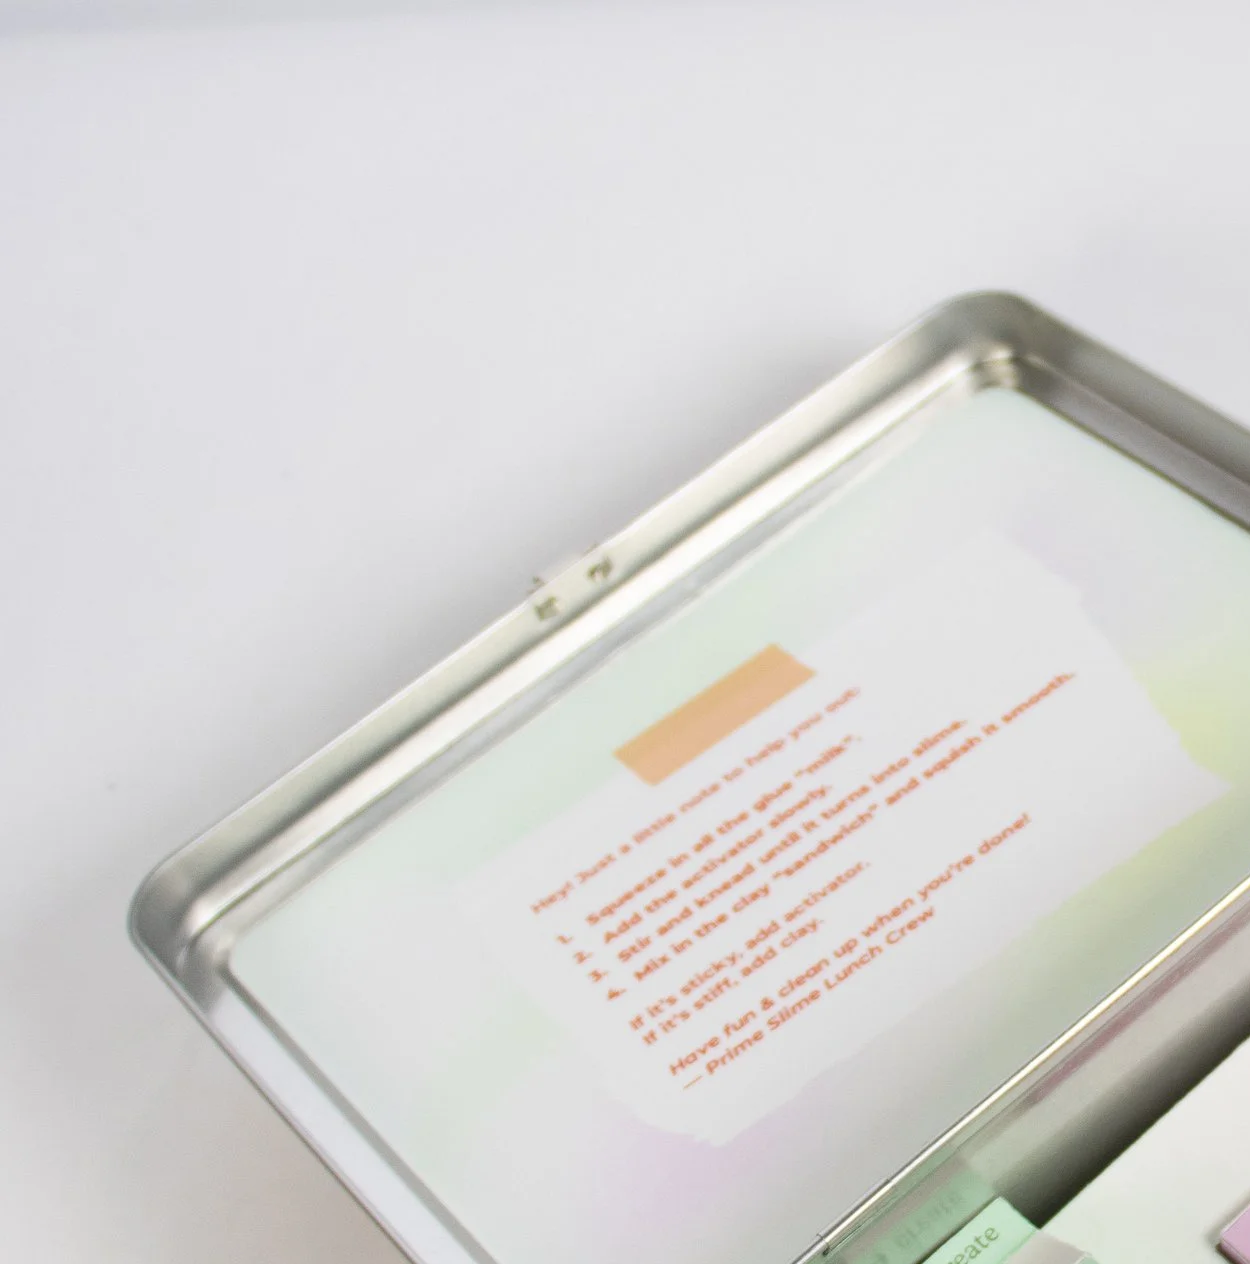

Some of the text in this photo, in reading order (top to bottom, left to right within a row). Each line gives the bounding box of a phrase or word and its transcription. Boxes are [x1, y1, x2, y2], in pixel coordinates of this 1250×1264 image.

[530, 880, 574, 914] Hey!
[575, 853, 616, 884] Just
[619, 843, 631, 854] a
[632, 813, 676, 844] little
[678, 782, 721, 813] note
[722, 767, 744, 782] to
[744, 738, 785, 767] help
[789, 712, 822, 740] you
[556, 934, 574, 945] 1.
[585, 868, 667, 926] Squeeze
[668, 853, 690, 868] in
[693, 832, 715, 853] all
[716, 811, 749, 835] the
[753, 781, 793, 813] glue
[573, 784, 832, 964] 2. Add the activator slowly.
[588, 719, 968, 982] 3. Stir and knead until it turns into slime.
[607, 989, 627, 1000] 4.
[634, 954, 670, 981] Mix
[671, 938, 692, 954] in
[693, 913, 728, 938] the
[732, 883, 770, 912] clay
[885, 776, 920, 806] and
[922, 736, 982, 779] squish
[982, 723, 999, 736] it
[1001, 673, 1074, 723] smooth.
[629, 1013, 644, 1031] If
[680, 952, 743, 996] sticky,
[745, 919, 780, 950] add
[784, 862, 870, 922] activator.
[642, 1029, 658, 1046] If
[693, 977, 739, 1010] stiff,
[741, 945, 777, 977] add
[780, 919, 824, 949] clay.
[669, 812, 1031, 1076] Have fun & clean up when you're done!
[705, 1030, 764, 1075] Prime
[767, 989, 821, 1031] Slime
[824, 945, 883, 990] Lunch
[885, 906, 935, 945] Crew
